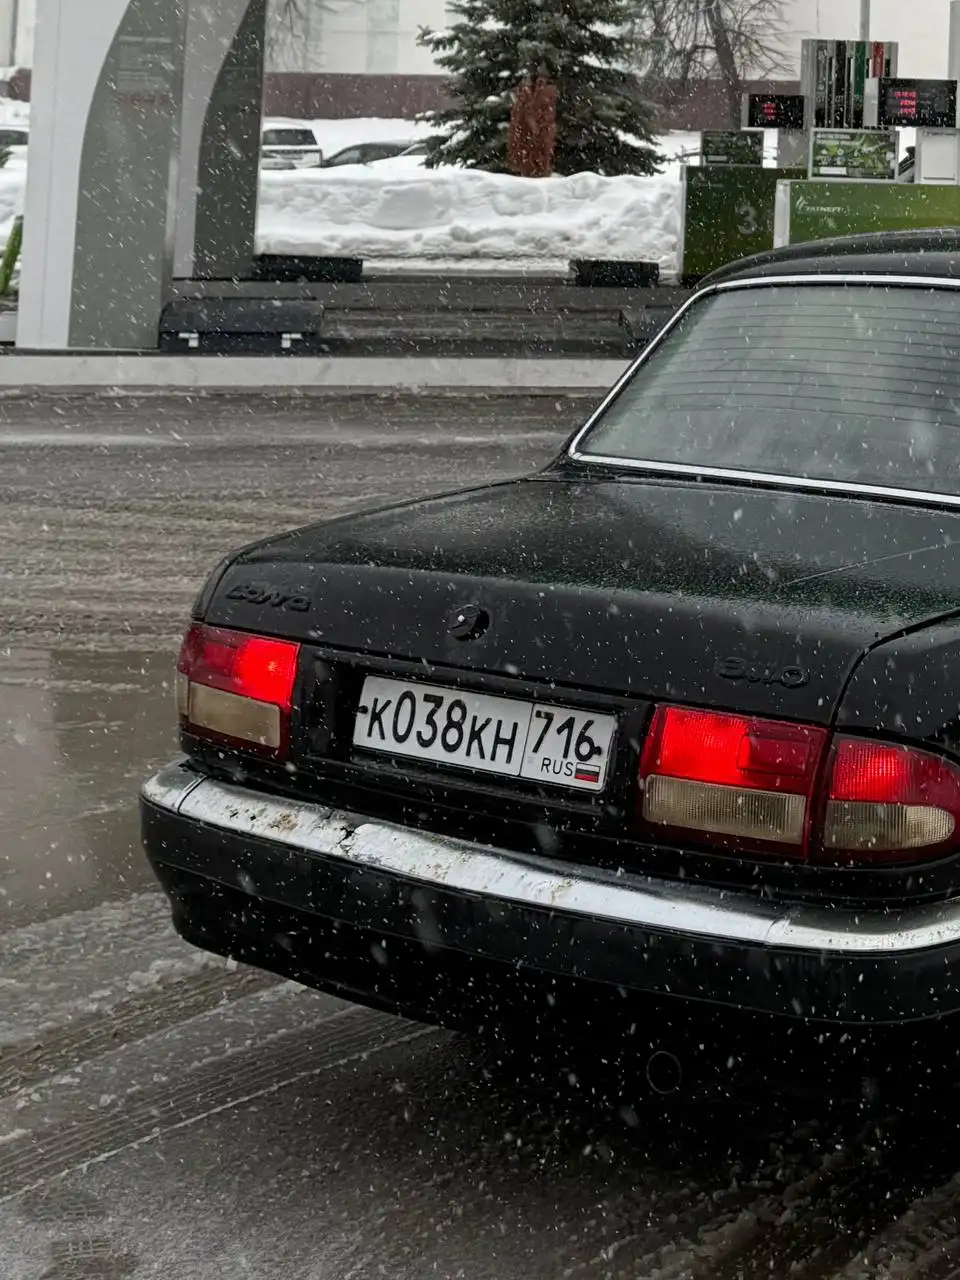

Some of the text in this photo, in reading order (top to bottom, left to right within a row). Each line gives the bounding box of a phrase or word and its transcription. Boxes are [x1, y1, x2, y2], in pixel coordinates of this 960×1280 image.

[734, 204, 757, 235] 3
[531, 709, 597, 762] 716
[540, 756, 574, 777] RUS
